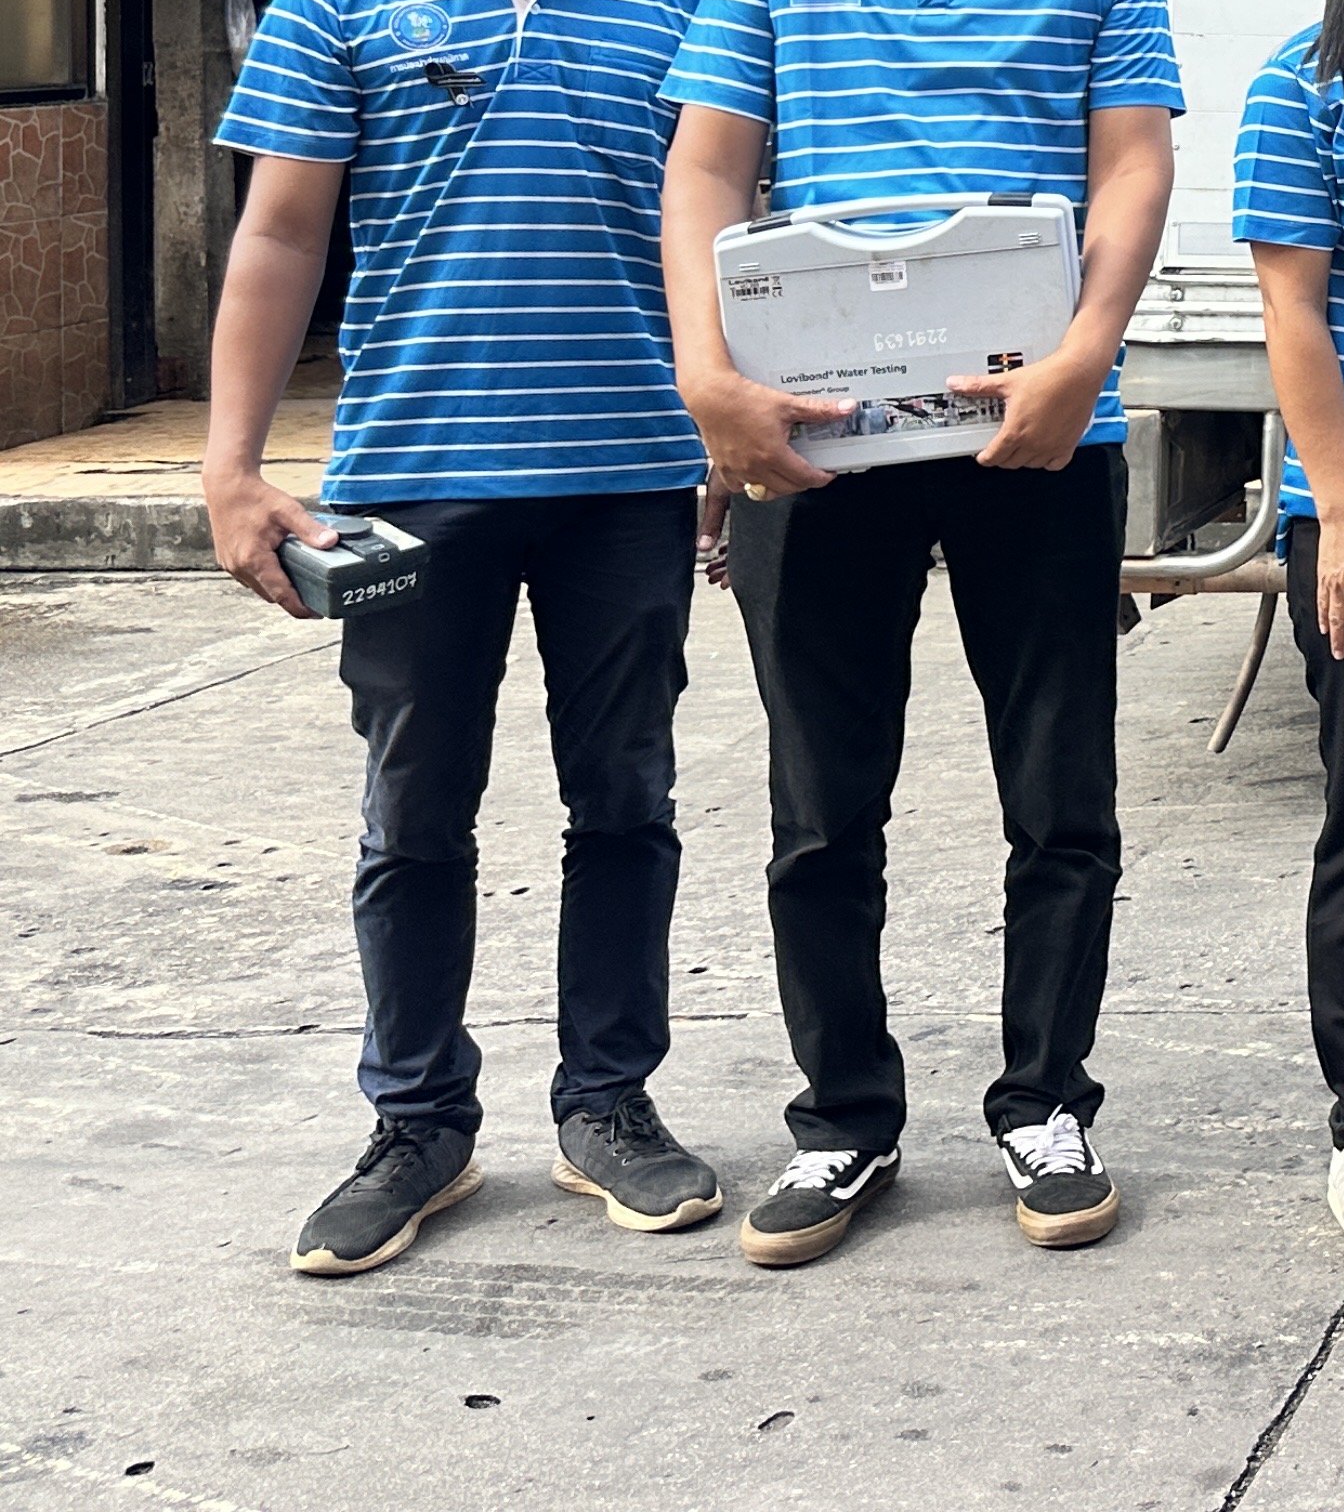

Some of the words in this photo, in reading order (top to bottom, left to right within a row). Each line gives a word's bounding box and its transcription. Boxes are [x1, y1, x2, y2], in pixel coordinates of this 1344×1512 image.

[873, 327, 948, 352] 2291639
[836, 368, 868, 379] Water
[870, 364, 907, 375] Testing
[342, 571, 417, 606] 2294107
